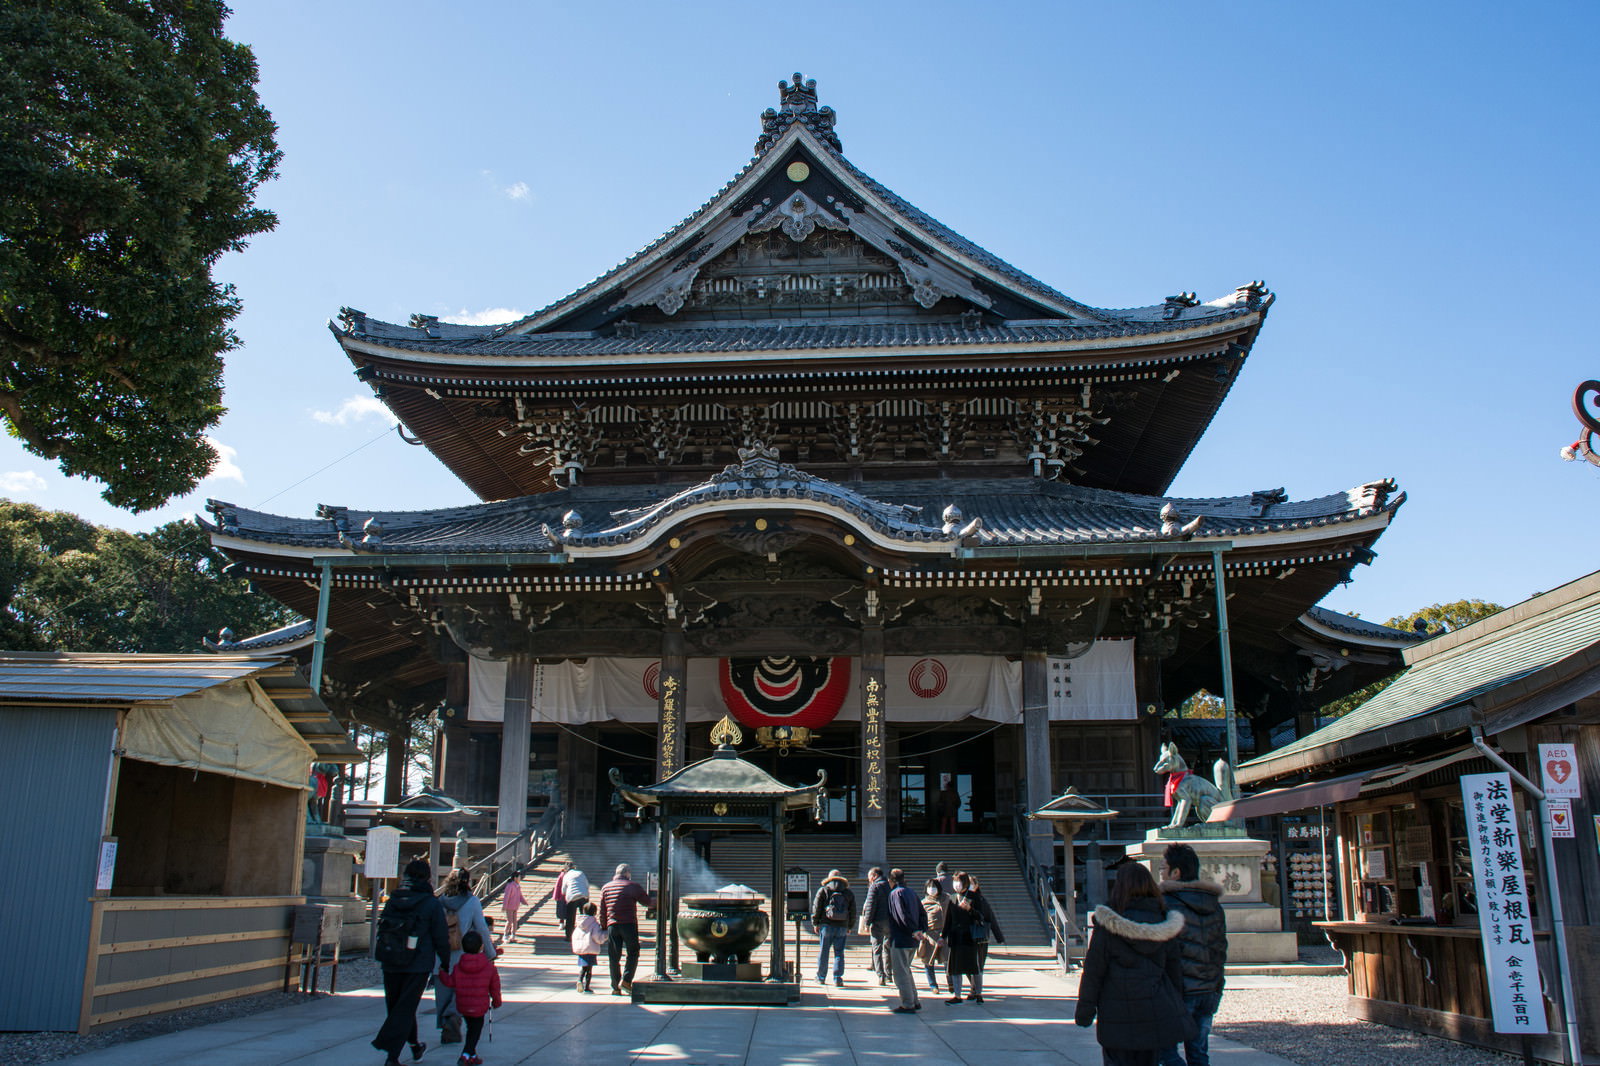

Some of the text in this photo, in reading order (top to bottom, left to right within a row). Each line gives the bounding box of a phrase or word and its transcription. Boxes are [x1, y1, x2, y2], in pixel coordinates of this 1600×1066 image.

[1547, 749, 1568, 758] AED
[1486, 780, 1531, 945] 法堂新築屋根瓦
